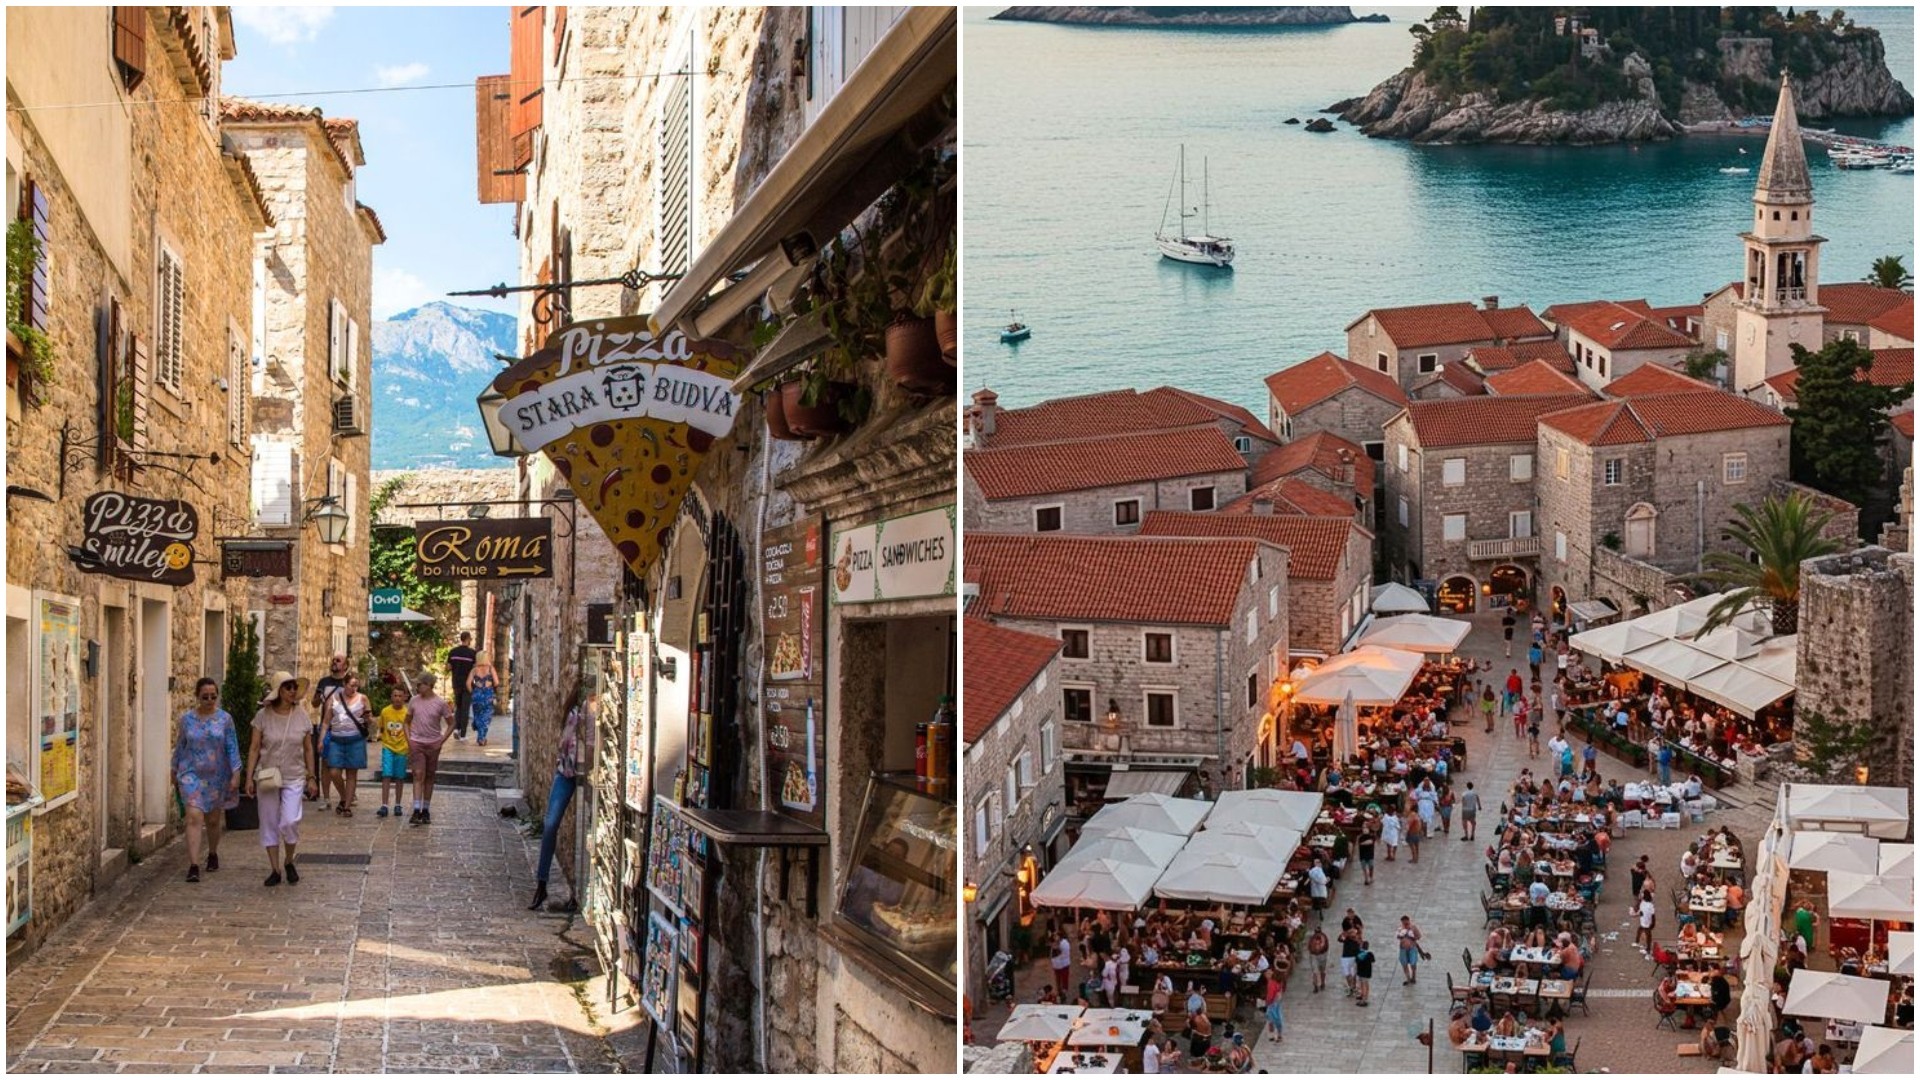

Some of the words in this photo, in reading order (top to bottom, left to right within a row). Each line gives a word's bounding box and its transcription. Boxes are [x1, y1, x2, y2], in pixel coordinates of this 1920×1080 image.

[555, 322, 694, 377] Pizza
[517, 385, 600, 431] STARA
[654, 376, 733, 418] BUDVA
[89, 493, 194, 537] Pizza
[418, 526, 547, 563] Roma
[852, 549, 873, 572] PIZZA
[882, 536, 945, 568] SANDWICHES
[423, 564, 488, 577] botique
